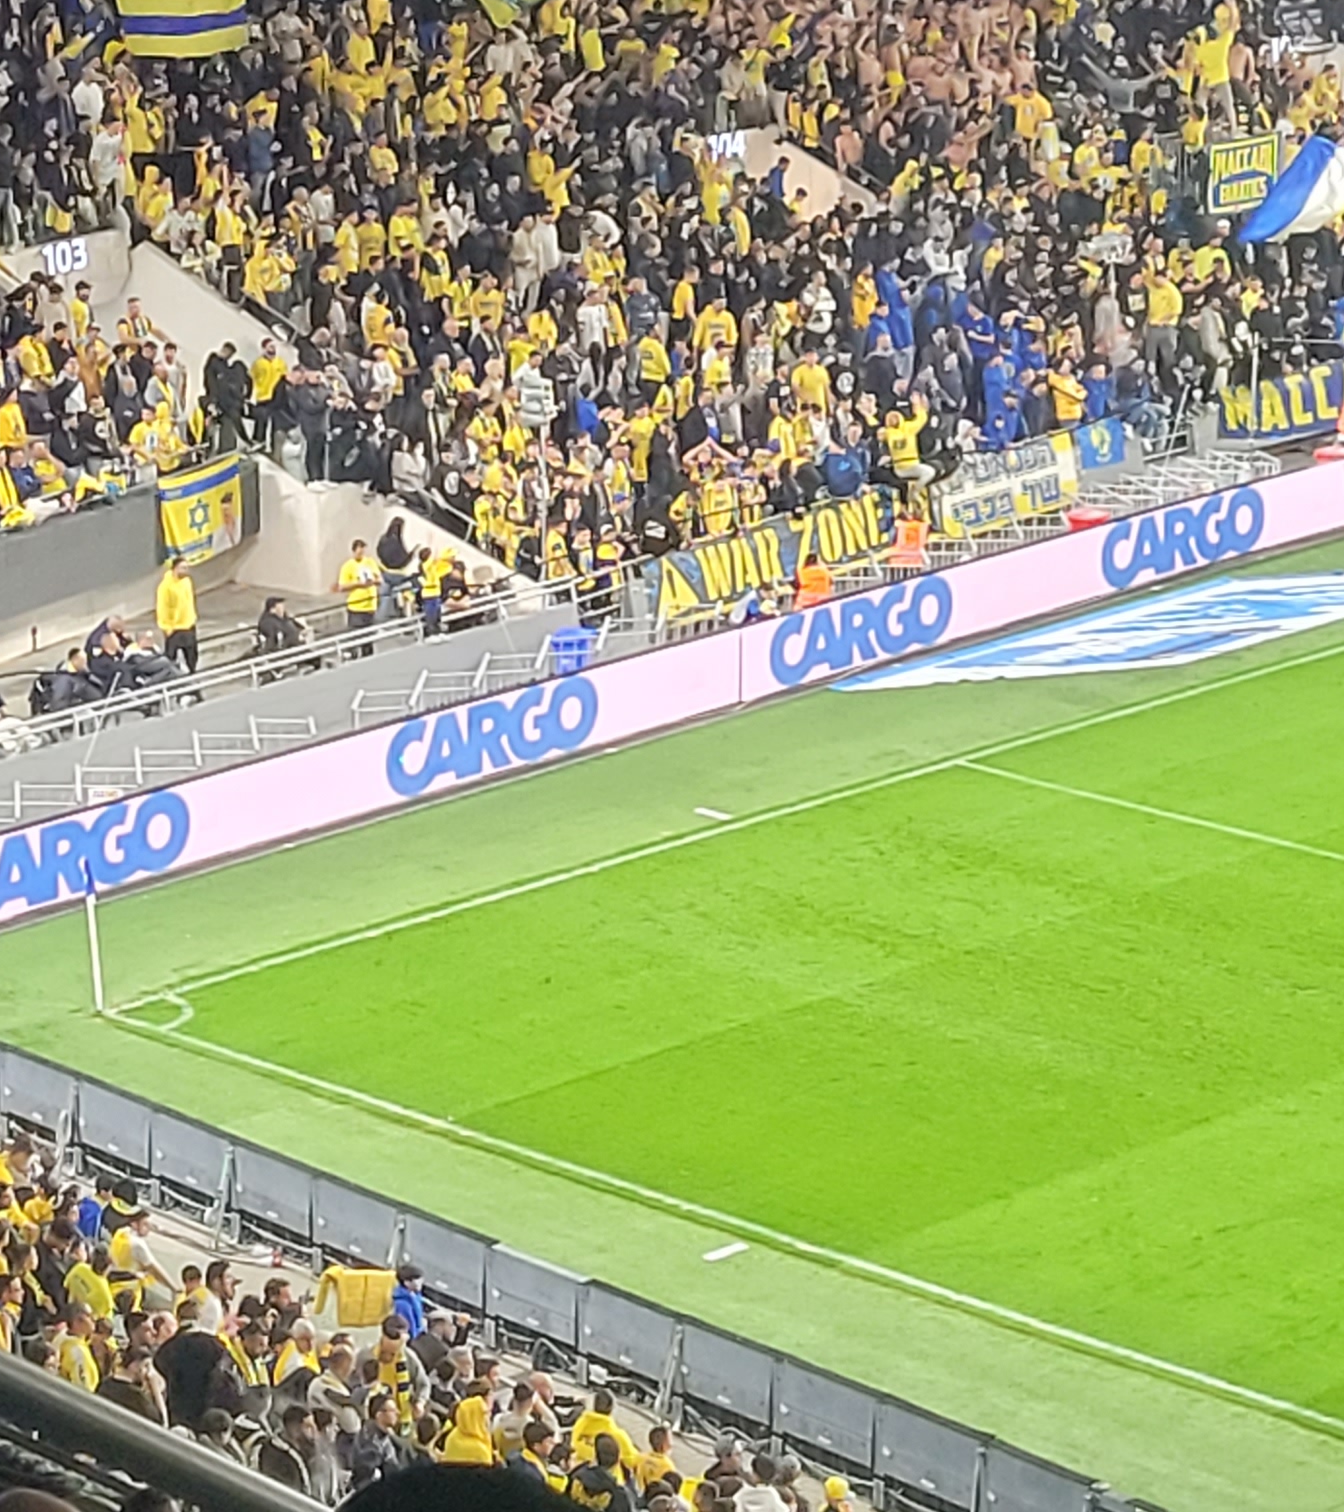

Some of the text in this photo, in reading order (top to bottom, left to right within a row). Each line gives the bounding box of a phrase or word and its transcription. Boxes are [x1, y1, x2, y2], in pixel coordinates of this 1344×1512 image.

[41, 238, 87, 276] 103
[696, 528, 784, 601] WAR
[789, 493, 889, 572] ZONE
[1102, 483, 1263, 588] CARGO
[771, 575, 951, 686] CARGO
[387, 673, 597, 796] CARGO
